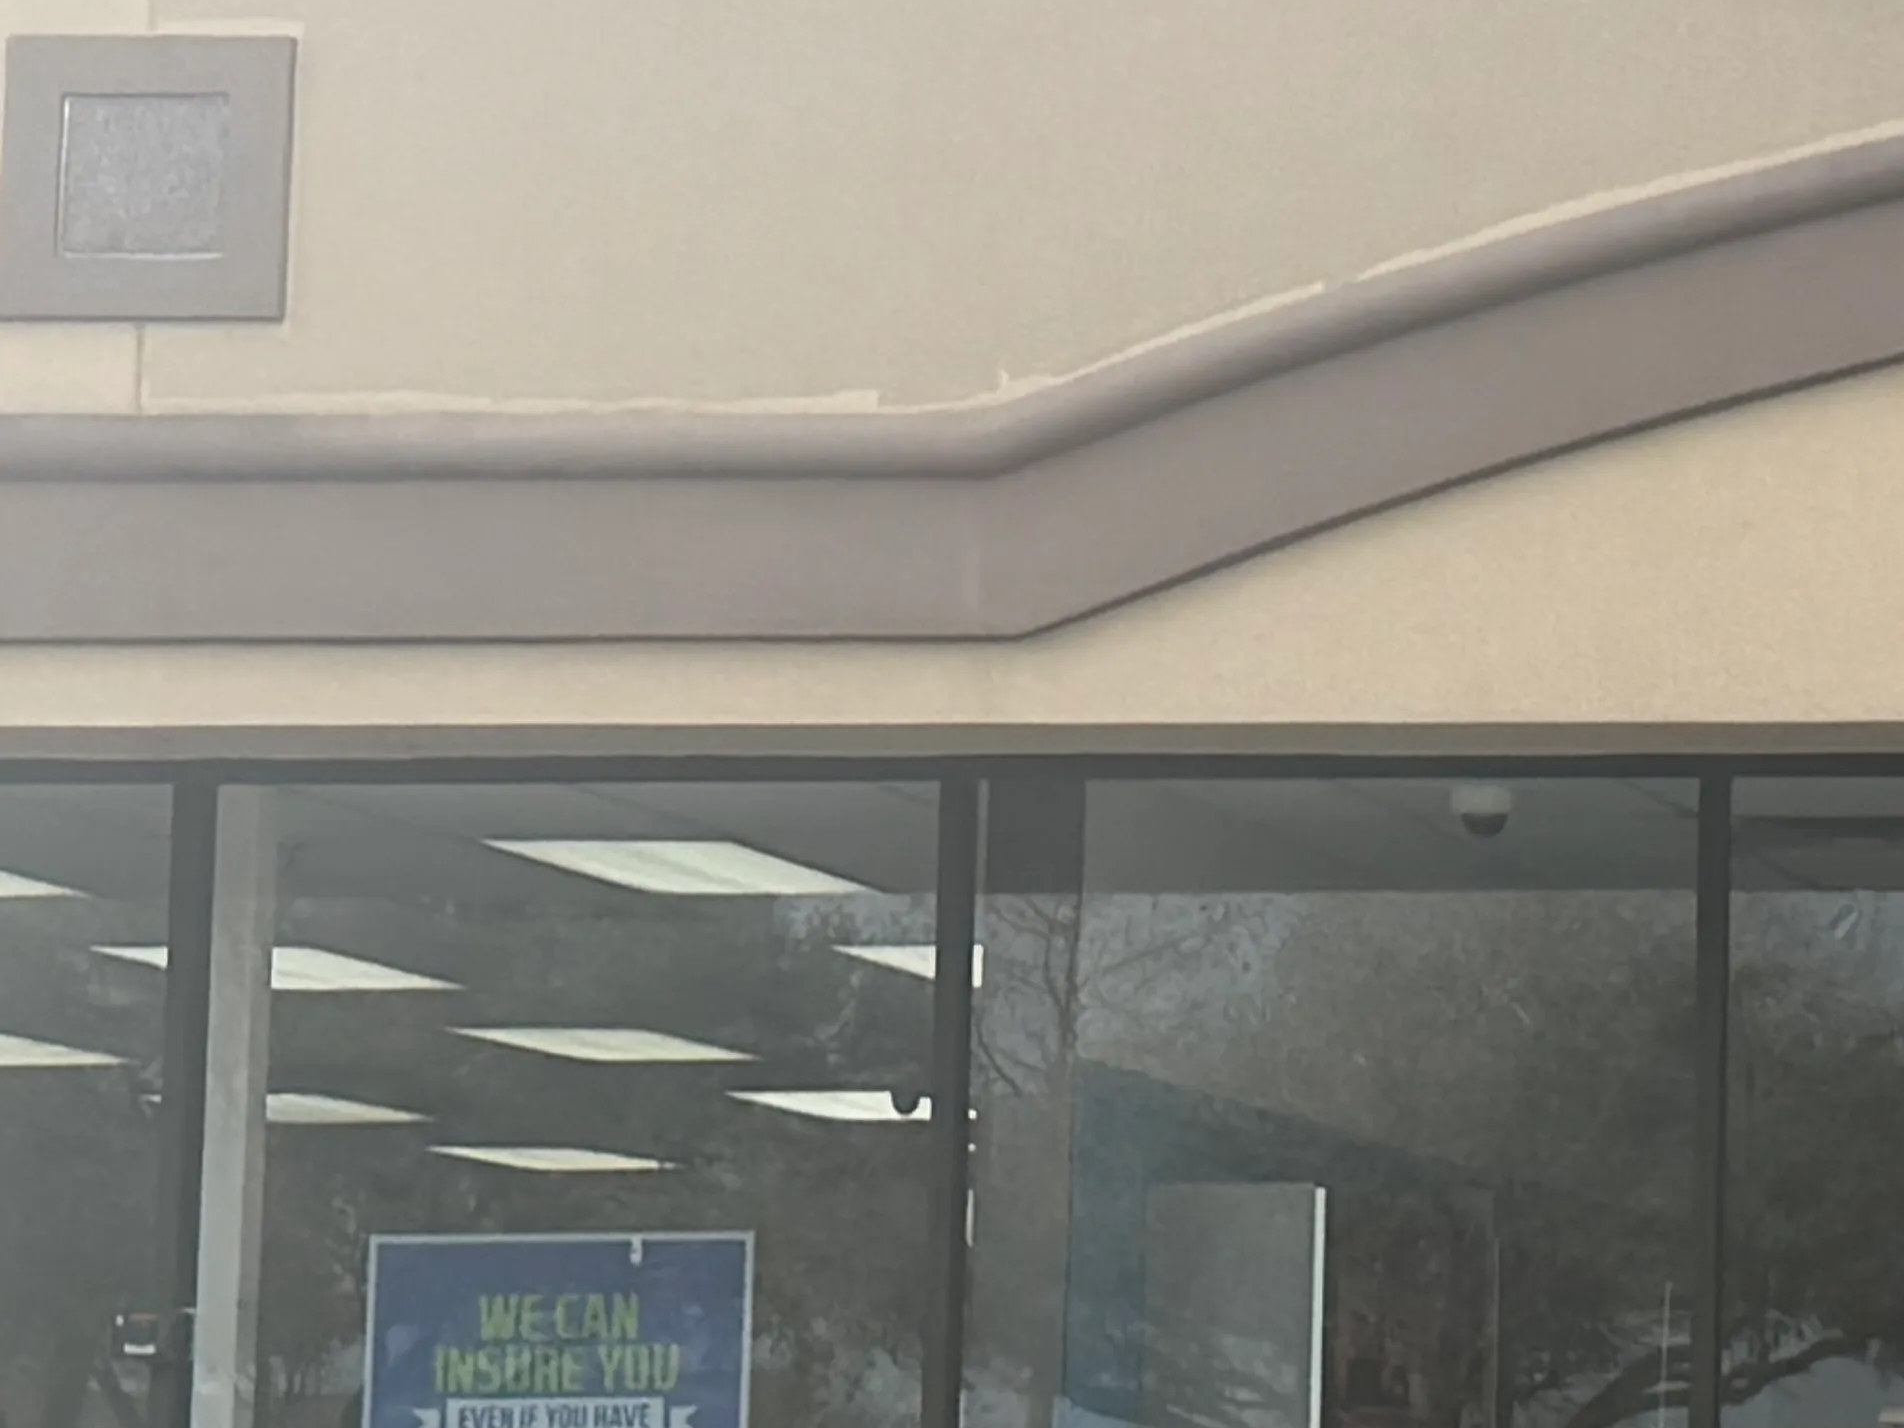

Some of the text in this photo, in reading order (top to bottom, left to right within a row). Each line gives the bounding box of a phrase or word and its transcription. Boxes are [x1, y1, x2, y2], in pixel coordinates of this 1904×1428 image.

[479, 1293, 638, 1339] WE CAN
[434, 1344, 680, 1392] INSURE YOU
[519, 1406, 537, 1428] IF
[546, 1405, 588, 1428] YOU
[594, 1404, 651, 1428] HAVE
